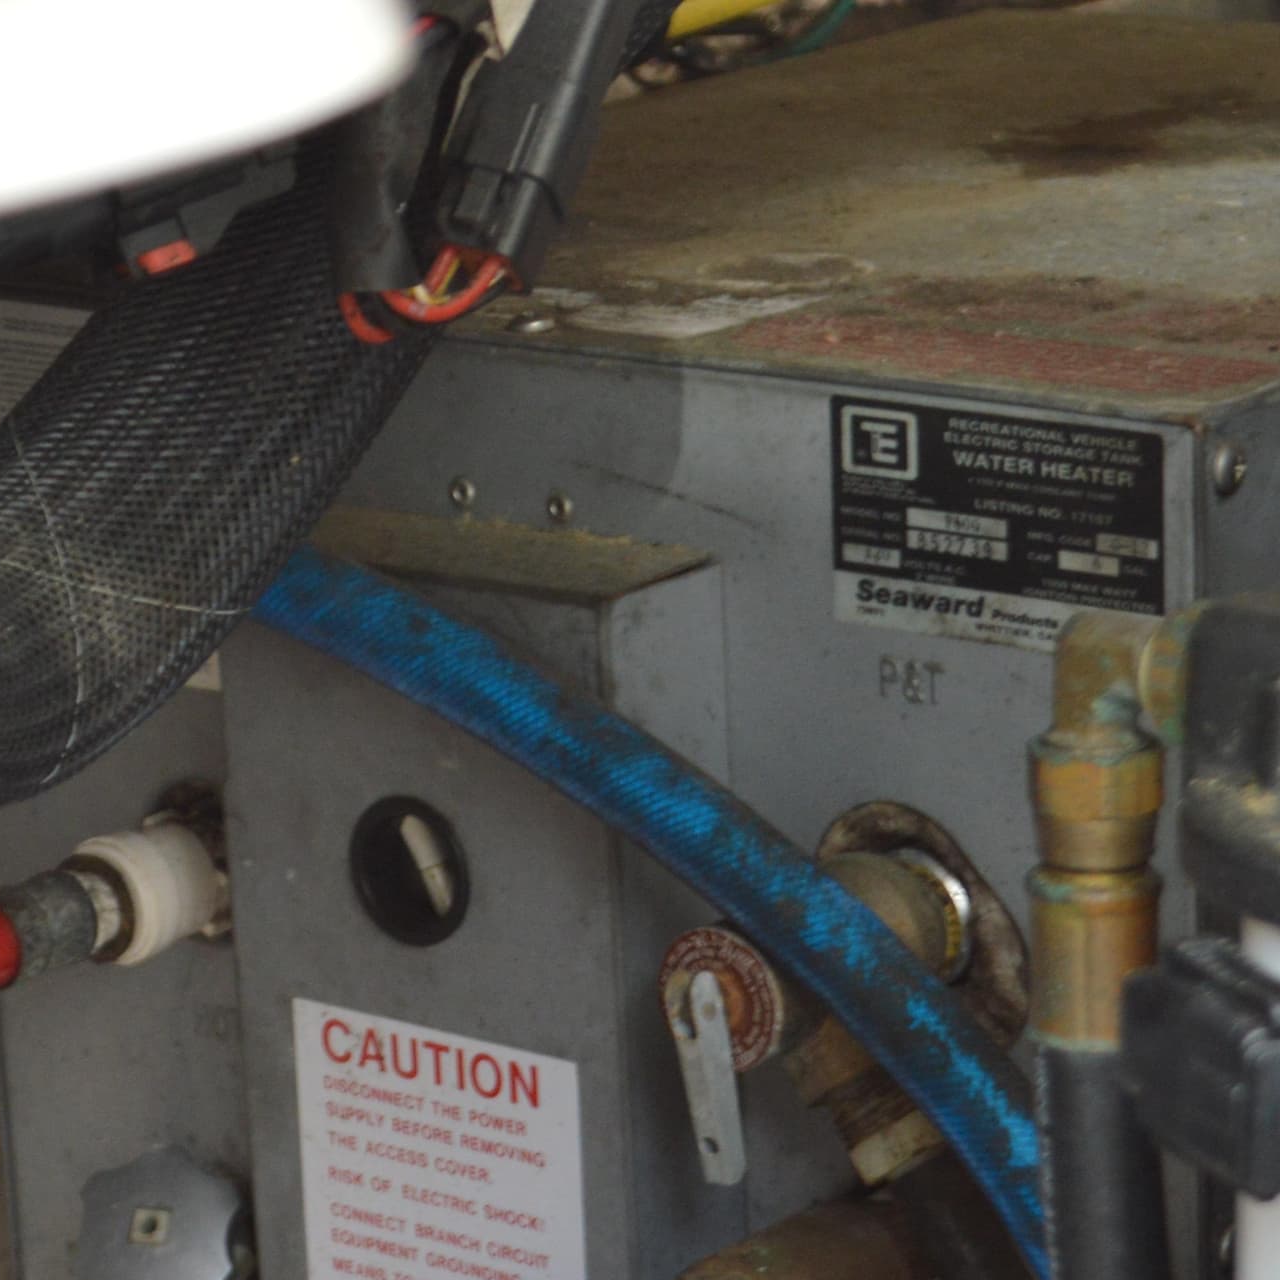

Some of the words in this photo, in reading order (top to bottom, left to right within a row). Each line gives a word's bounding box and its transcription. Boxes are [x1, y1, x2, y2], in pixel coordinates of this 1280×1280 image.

[943, 431, 1019, 451] ELECTRIC
[1023, 442, 1096, 462] STORAGE
[1101, 452, 1143, 466] TANK
[948, 417, 1067, 444] RECREATIONAL
[1071, 433, 1137, 451] VEHICLE
[952, 450, 1035, 477] WATER
[1040, 461, 1135, 489] HEATER
[974, 499, 1034, 517] LISTING
[857, 578, 986, 618] Seaward
[992, 609, 1059, 629] Products
[878, 656, 944, 705] P&T
[321, 1018, 540, 1108] CAUTION
[323, 1075, 424, 1111] DISCONNECT
[432, 1101, 461, 1121] THE
[468, 1110, 527, 1137] POWER
[325, 1100, 385, 1126] SUPPLY
[392, 1118, 453, 1146] BEFORE
[460, 1134, 547, 1169] REMOVING
[328, 1131, 358, 1151] THE
[365, 1143, 429, 1169] ACCESS
[434, 1157, 493, 1184] COVER.
[327, 1166, 363, 1187] RISK
[370, 1176, 392, 1192] OF
[401, 1184, 477, 1216] ELECTRIC
[329, 1202, 406, 1234] CONNECT
[415, 1223, 480, 1253] BRANCH
[486, 1241, 550, 1271] CIRCUIT
[330, 1228, 419, 1262] EQUIPMENT
